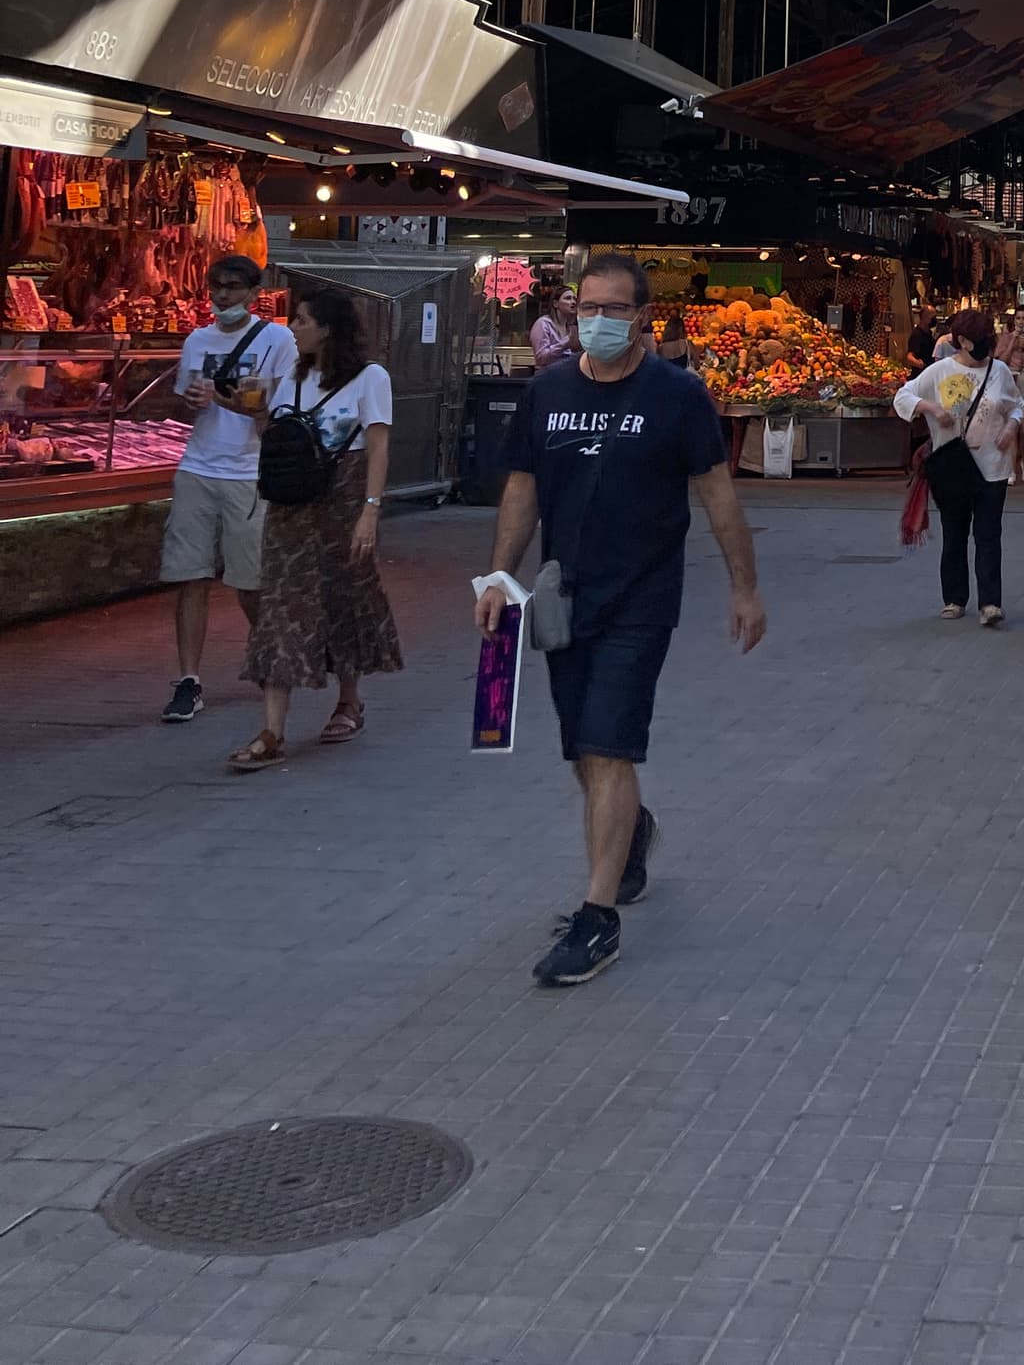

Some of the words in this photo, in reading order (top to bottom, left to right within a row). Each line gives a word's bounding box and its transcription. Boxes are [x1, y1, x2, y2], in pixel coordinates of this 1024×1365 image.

[86, 30, 118, 60] 888
[654, 196, 727, 225] 1897
[547, 412, 645, 433] HOLLISER
